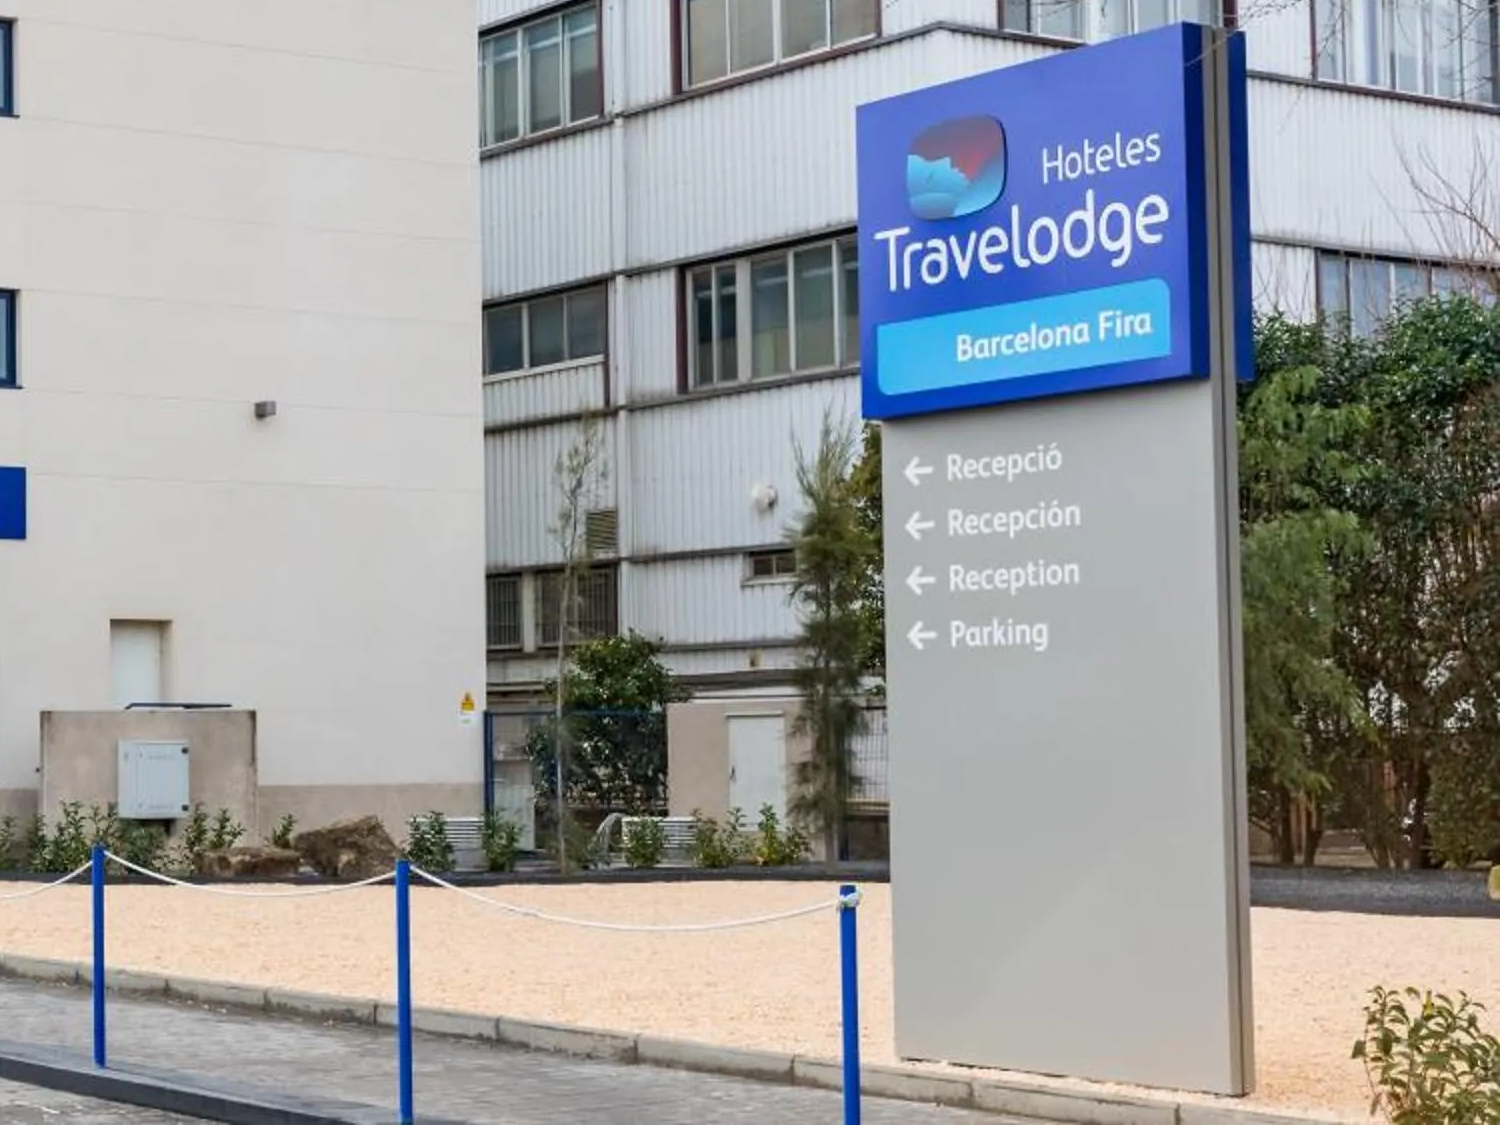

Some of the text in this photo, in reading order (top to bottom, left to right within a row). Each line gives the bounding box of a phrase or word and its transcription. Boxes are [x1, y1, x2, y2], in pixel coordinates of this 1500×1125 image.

[1043, 132, 1161, 184] Hoteles
[874, 189, 1169, 291] Travelodge
[956, 309, 1153, 362] Barcelona Fira
[946, 442, 1063, 483] Recepció
[947, 499, 1081, 539] Recepción
[949, 559, 1080, 596] Reception
[950, 617, 1049, 652] Parking
